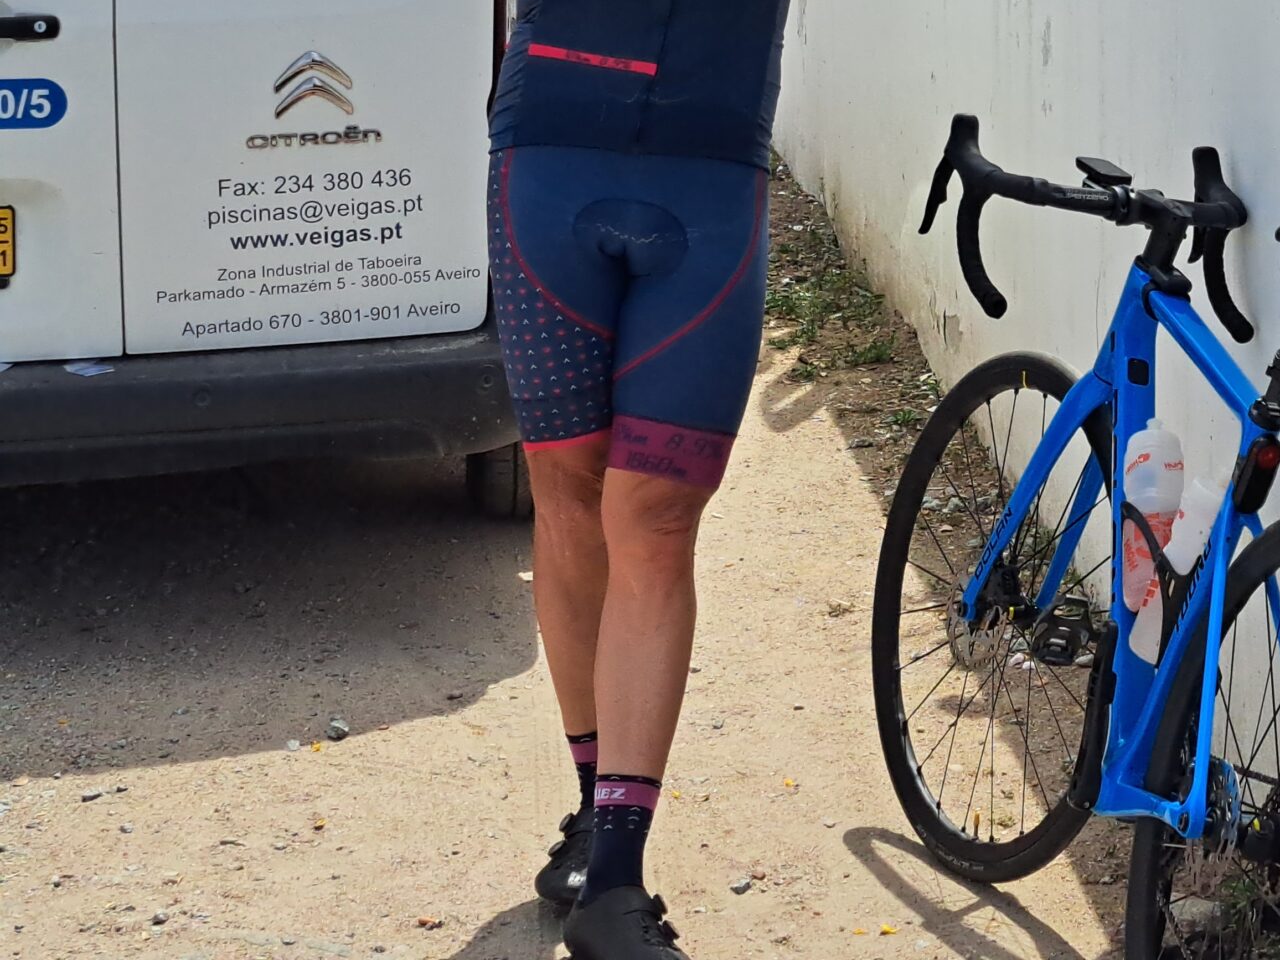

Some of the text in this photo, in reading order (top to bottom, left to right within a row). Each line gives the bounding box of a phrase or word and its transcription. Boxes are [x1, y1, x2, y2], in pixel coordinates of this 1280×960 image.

[246, 125, 382, 150] CITROËN
[217, 168, 412, 197] Fax: 234 380 436
[207, 194, 424, 229] piscinas@veigas.pt
[229, 222, 404, 251] www.veigas.pt
[217, 253, 423, 282] Zona Industrial de Taboeira
[156, 285, 245, 304] Parkamado
[259, 279, 332, 298] Armazém
[336, 277, 347, 291] 5
[360, 269, 431, 289] 3800-055
[435, 266, 481, 283] Aveiro
[182, 316, 263, 338] Apartado
[269, 313, 302, 330] 670
[320, 305, 402, 327] 3801-901
[407, 300, 461, 319] Aveiro
[974, 506, 1013, 581] DOLAN
